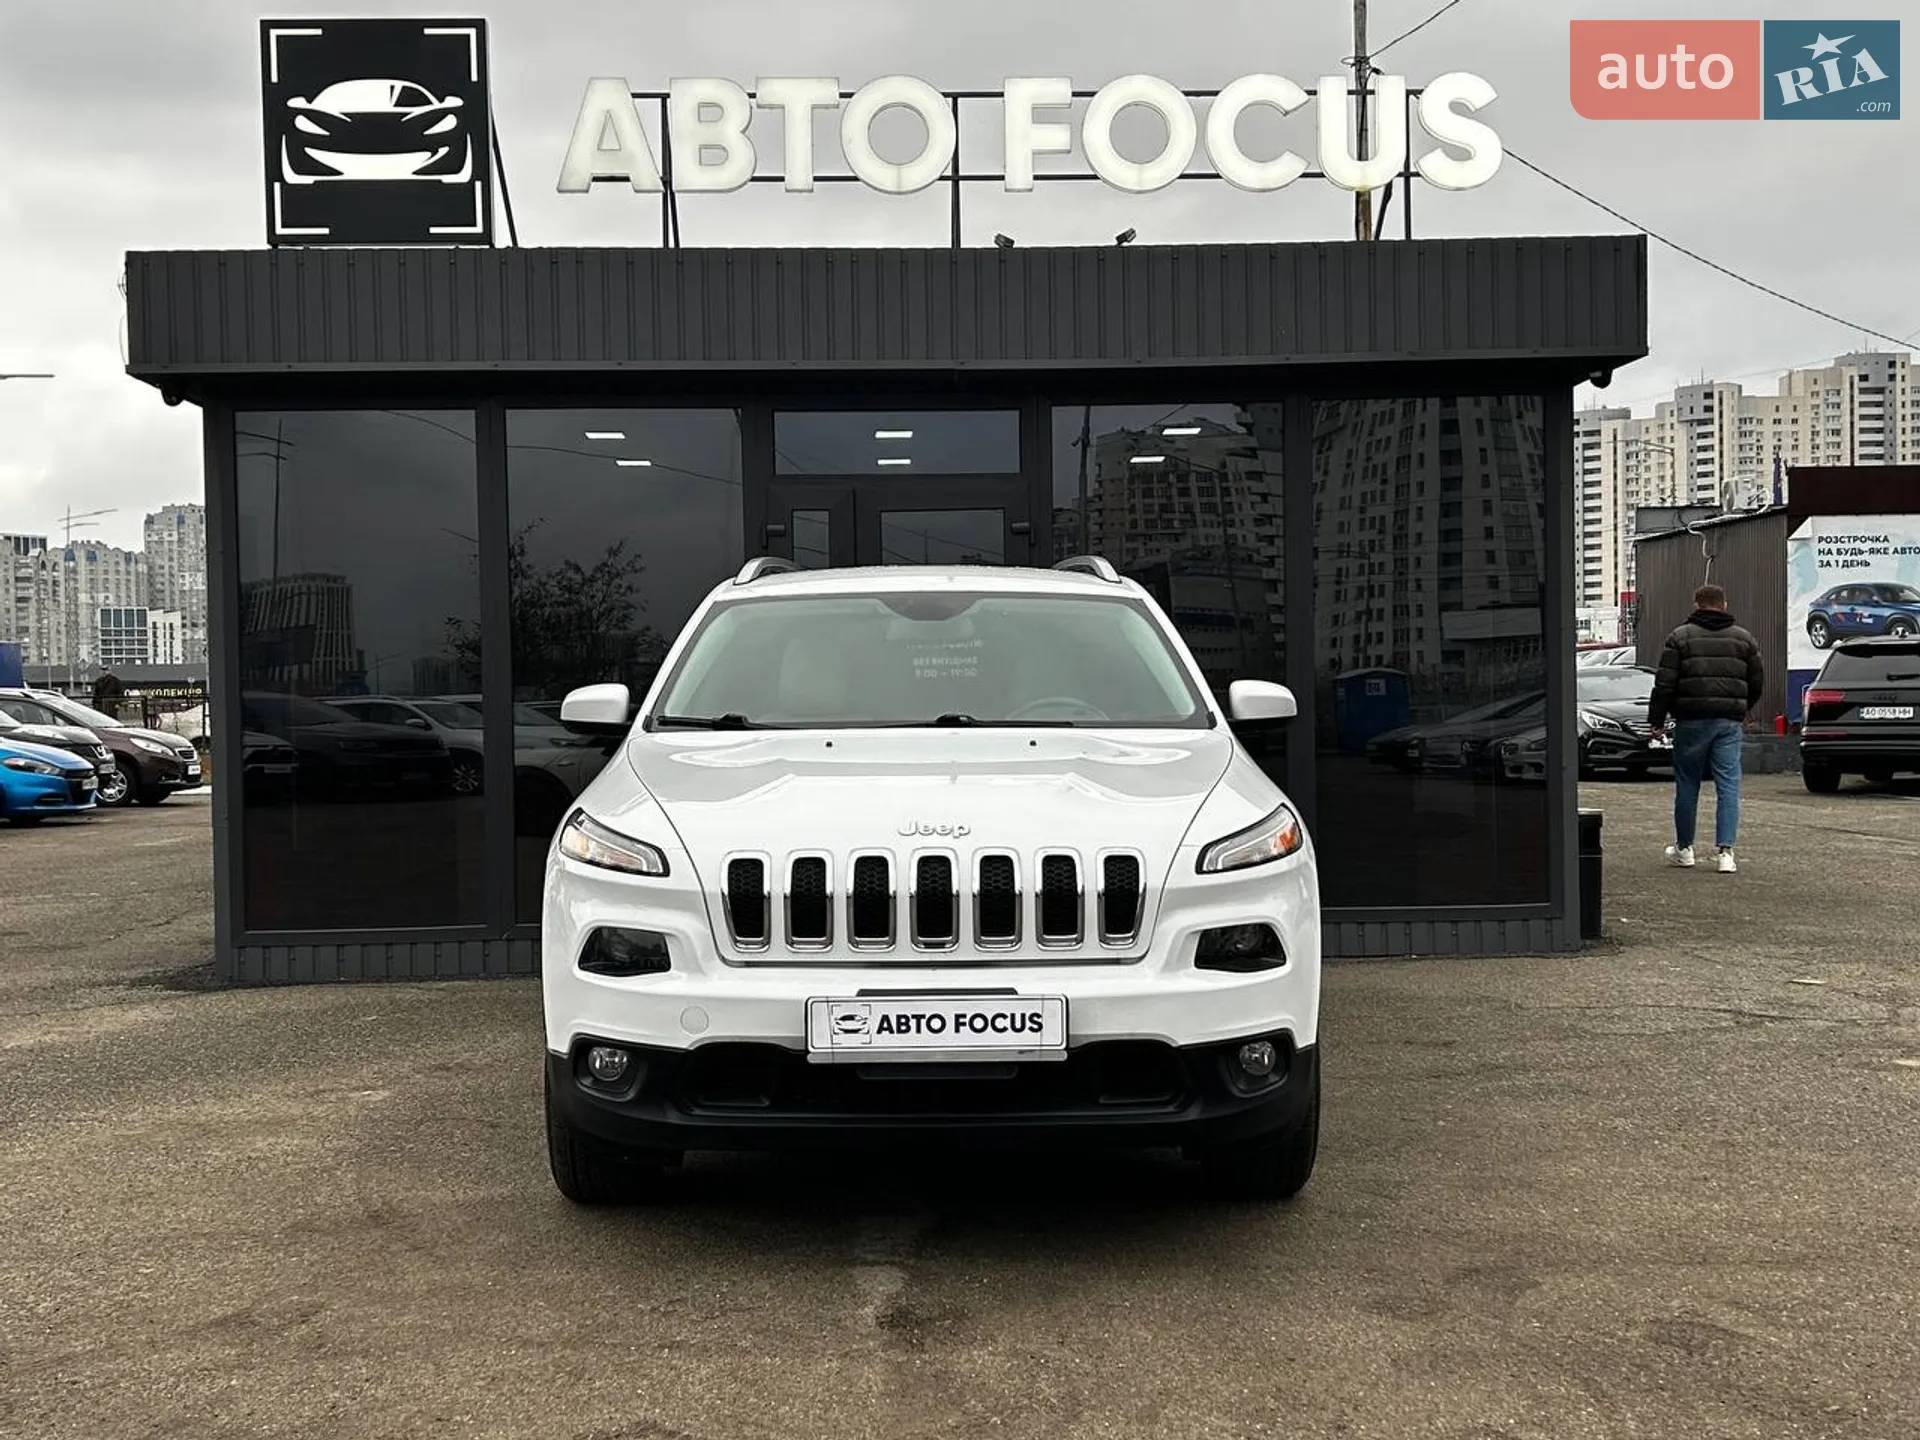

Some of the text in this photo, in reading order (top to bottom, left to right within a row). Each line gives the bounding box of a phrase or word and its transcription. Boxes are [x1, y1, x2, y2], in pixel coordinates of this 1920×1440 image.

[557, 71, 1503, 195] АВТО FOCUS
[1817, 535, 1890, 544] РОЗСТРОЧКА
[1817, 545, 1920, 556] НА БУДЬ-ЯКЕ АВТО
[1818, 559, 1871, 569] ЗА 1 ДЕНЬ
[897, 818, 971, 839] Jeep
[876, 1012, 1044, 1035] АВТО FOCUS
